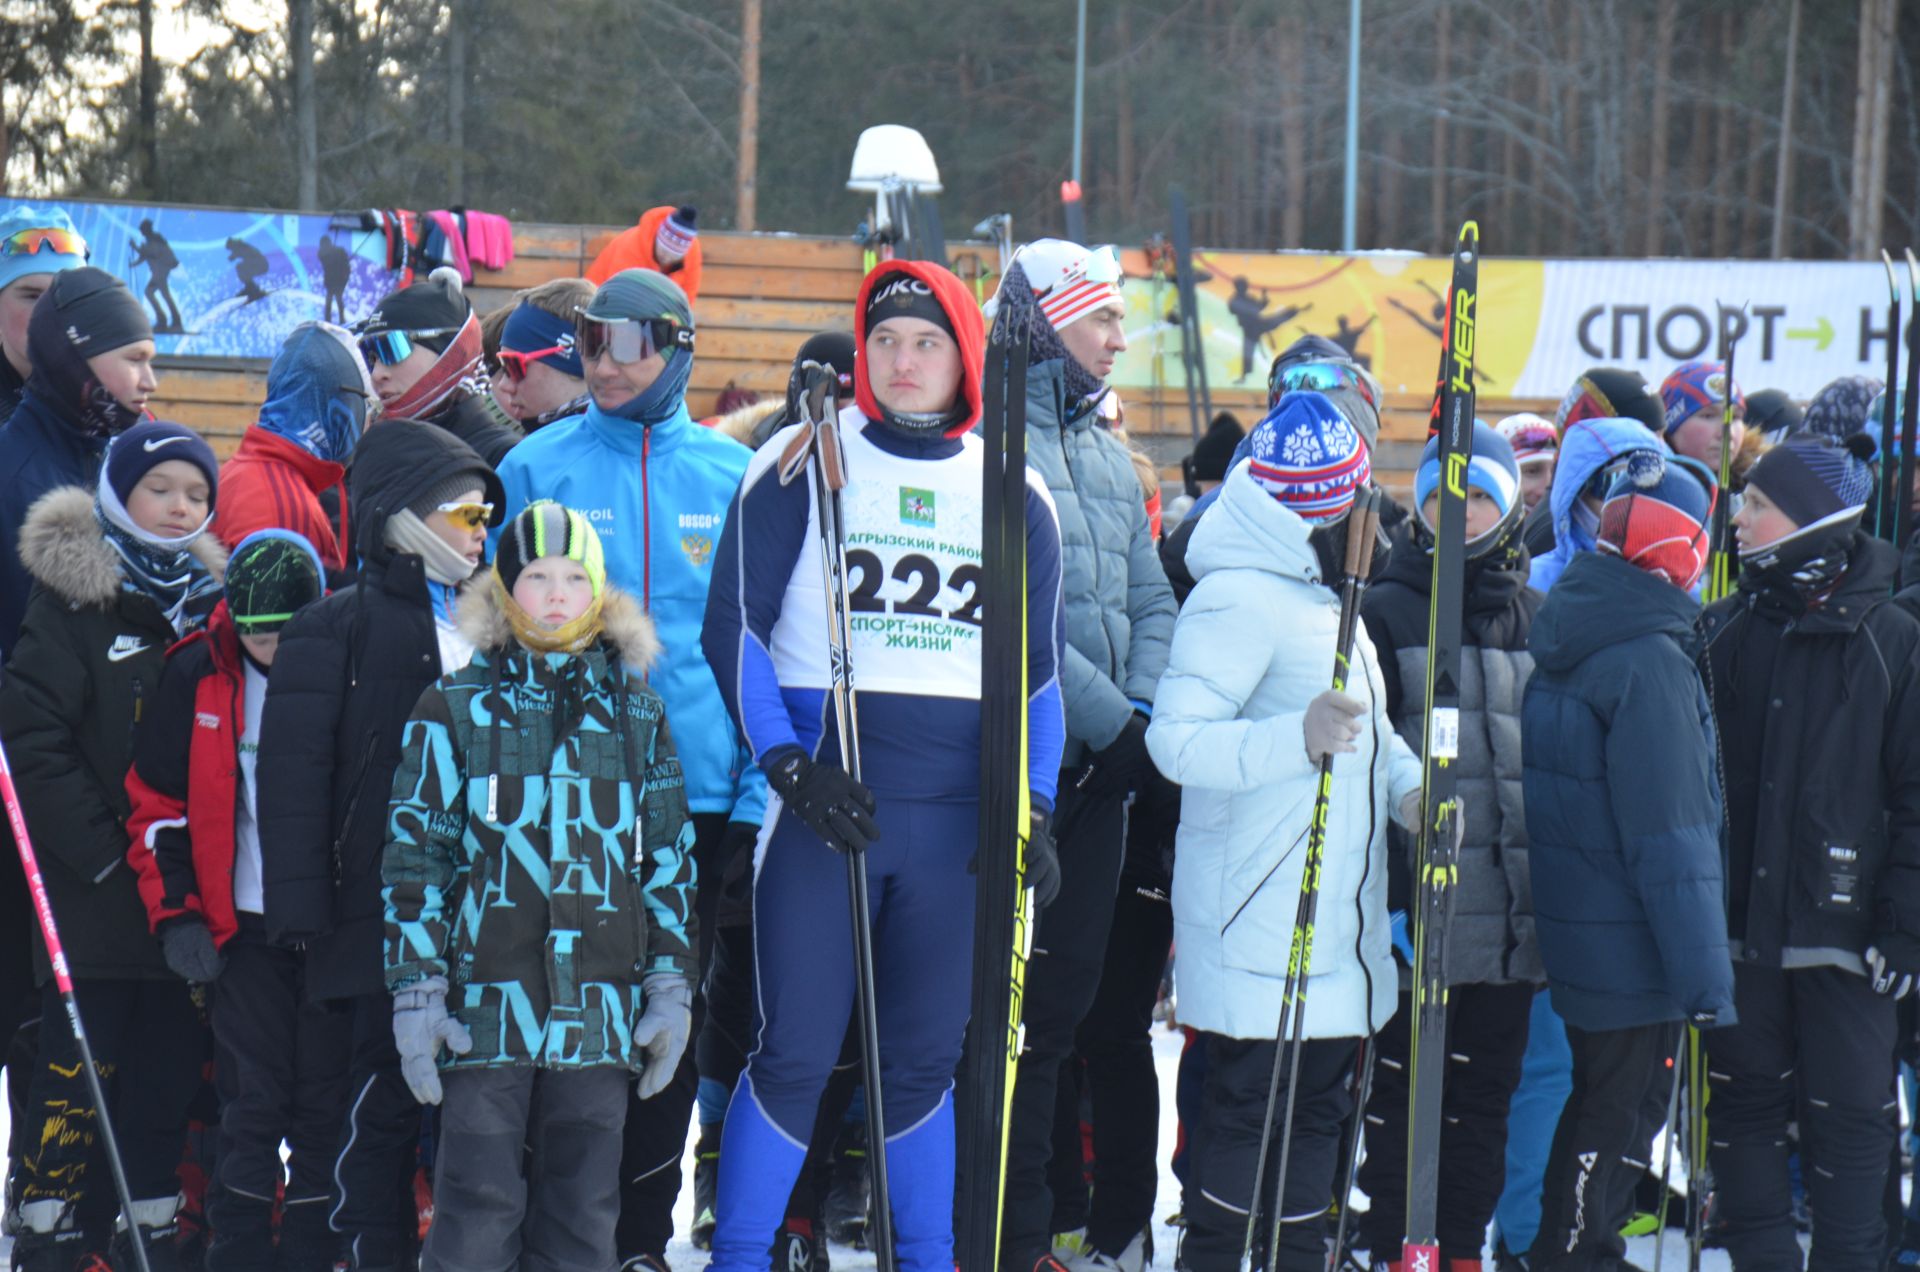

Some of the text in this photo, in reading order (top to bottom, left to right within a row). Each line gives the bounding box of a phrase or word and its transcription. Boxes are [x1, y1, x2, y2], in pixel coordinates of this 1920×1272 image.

[1577, 304, 1920, 362] СПОРТ Н
[1446, 287, 1477, 500] FIHER
[1451, 396, 1462, 448] NORDSKI
[678, 513, 712, 529] BOSCO
[847, 532, 983, 561] АГРЫЗСКИЙ РАЙОН
[845, 548, 983, 627] 222
[113, 634, 142, 651] NIKE
[884, 633, 952, 652] ЖИЗНИ
